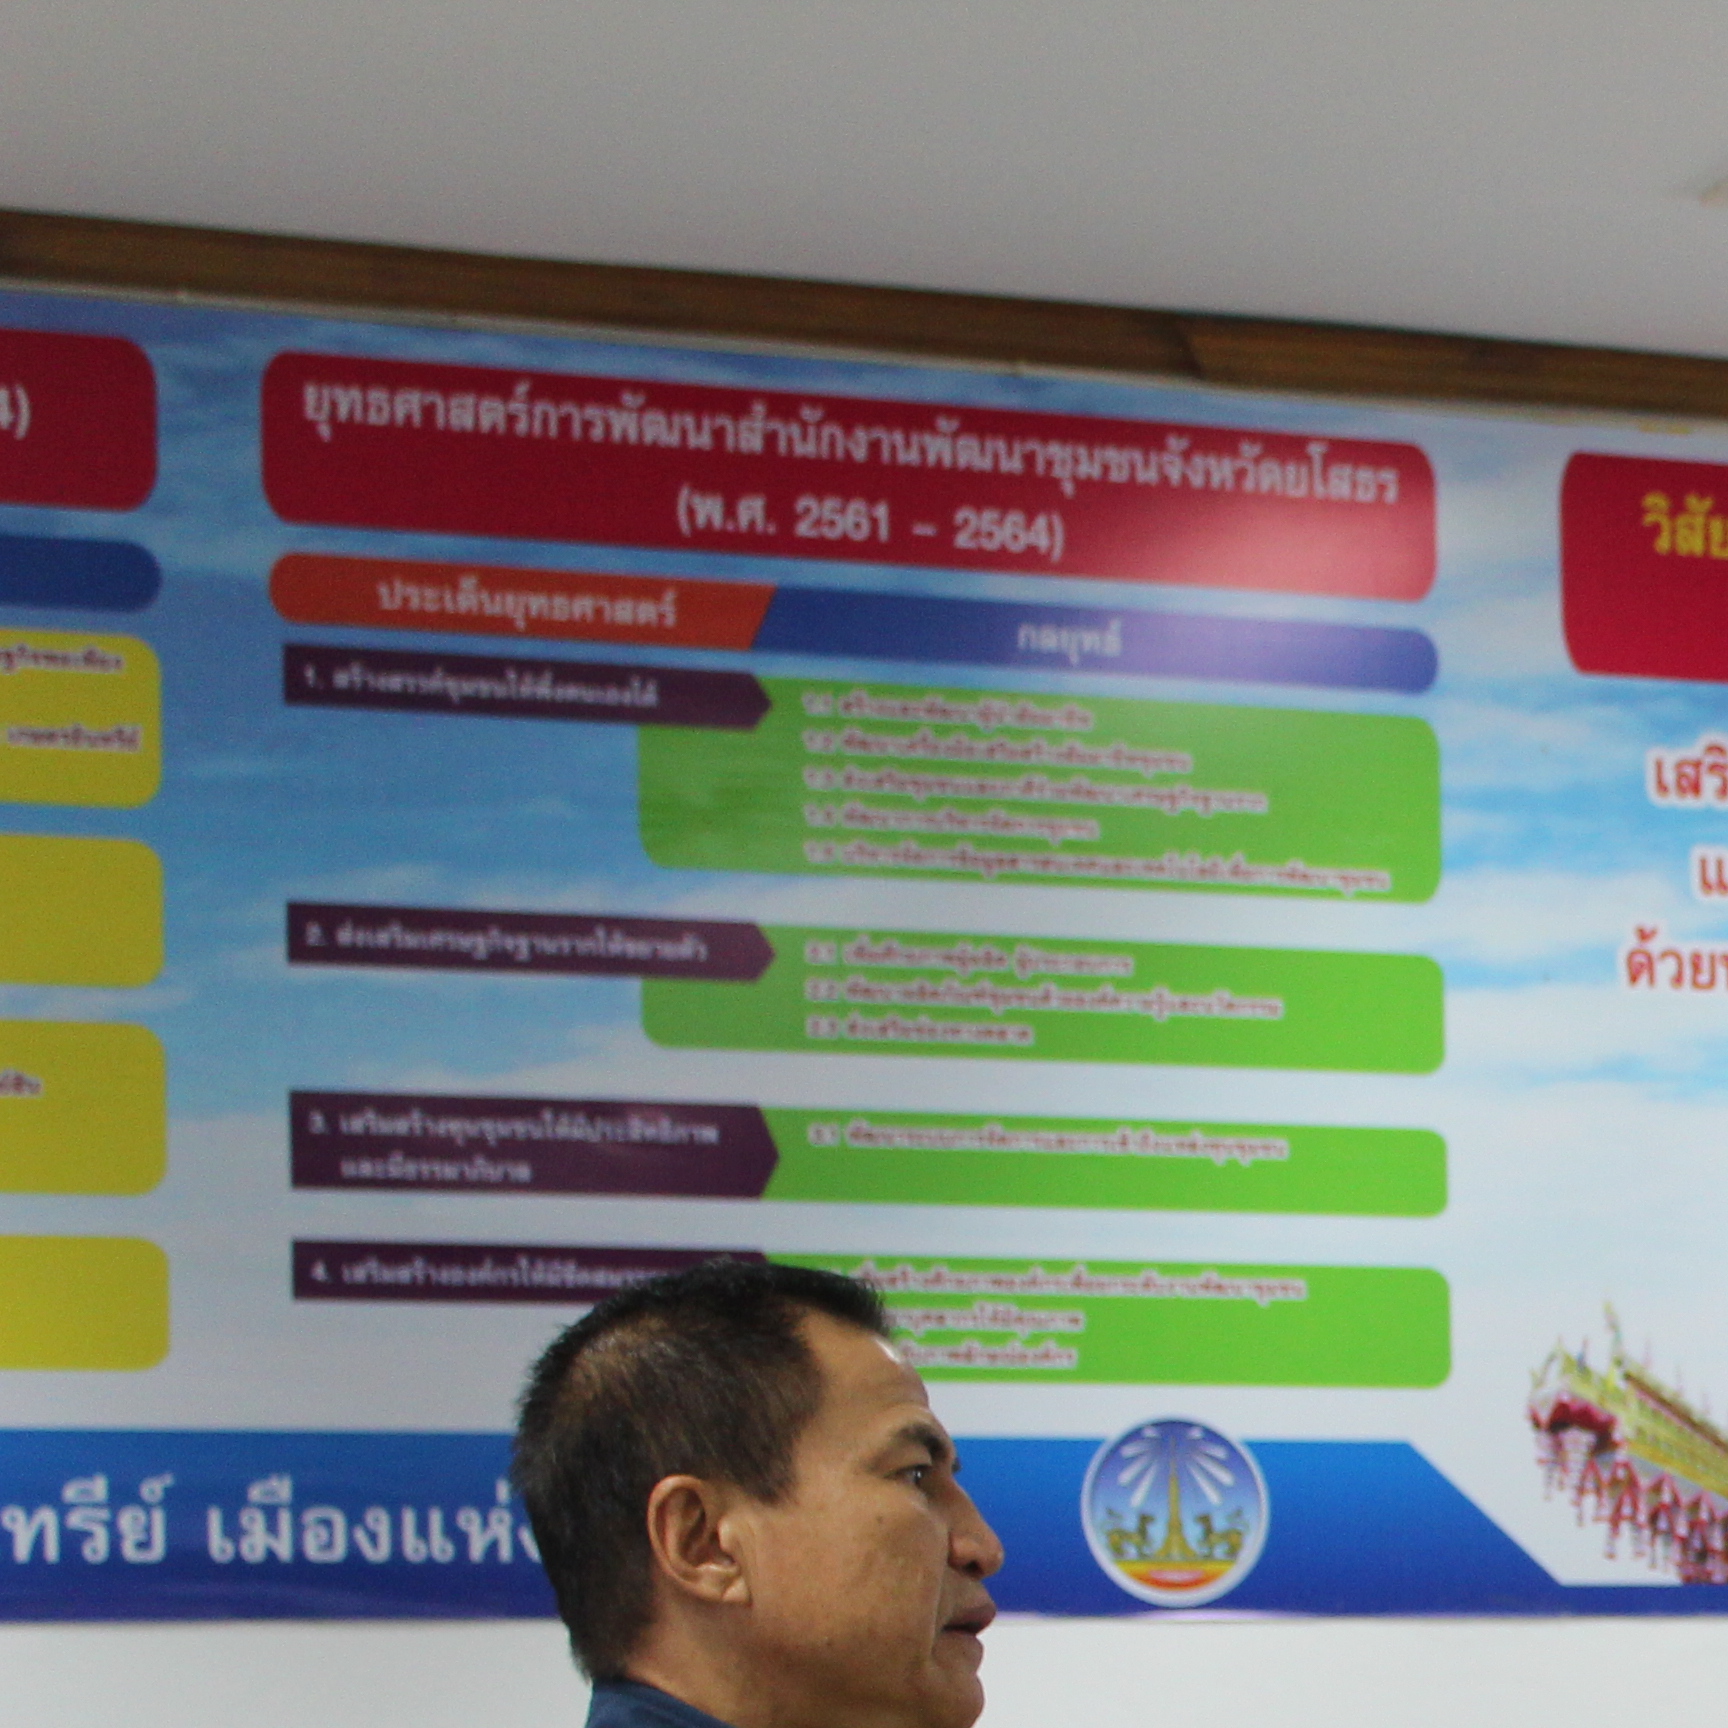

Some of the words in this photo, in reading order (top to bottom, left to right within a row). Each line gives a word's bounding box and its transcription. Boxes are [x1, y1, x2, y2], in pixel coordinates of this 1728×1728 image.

[303, 379, 1400, 505] ยุทธศาสตร์การพัฒนาสำนักงานพัฒนาชุมชนจังหวัดยโสธร
[676, 483, 776, 536] (พ.ศ.
[795, 494, 890, 544] 2561
[953, 505, 1066, 562] 2564)
[377, 575, 678, 629] ประเด็นยุทธศาสตร์
